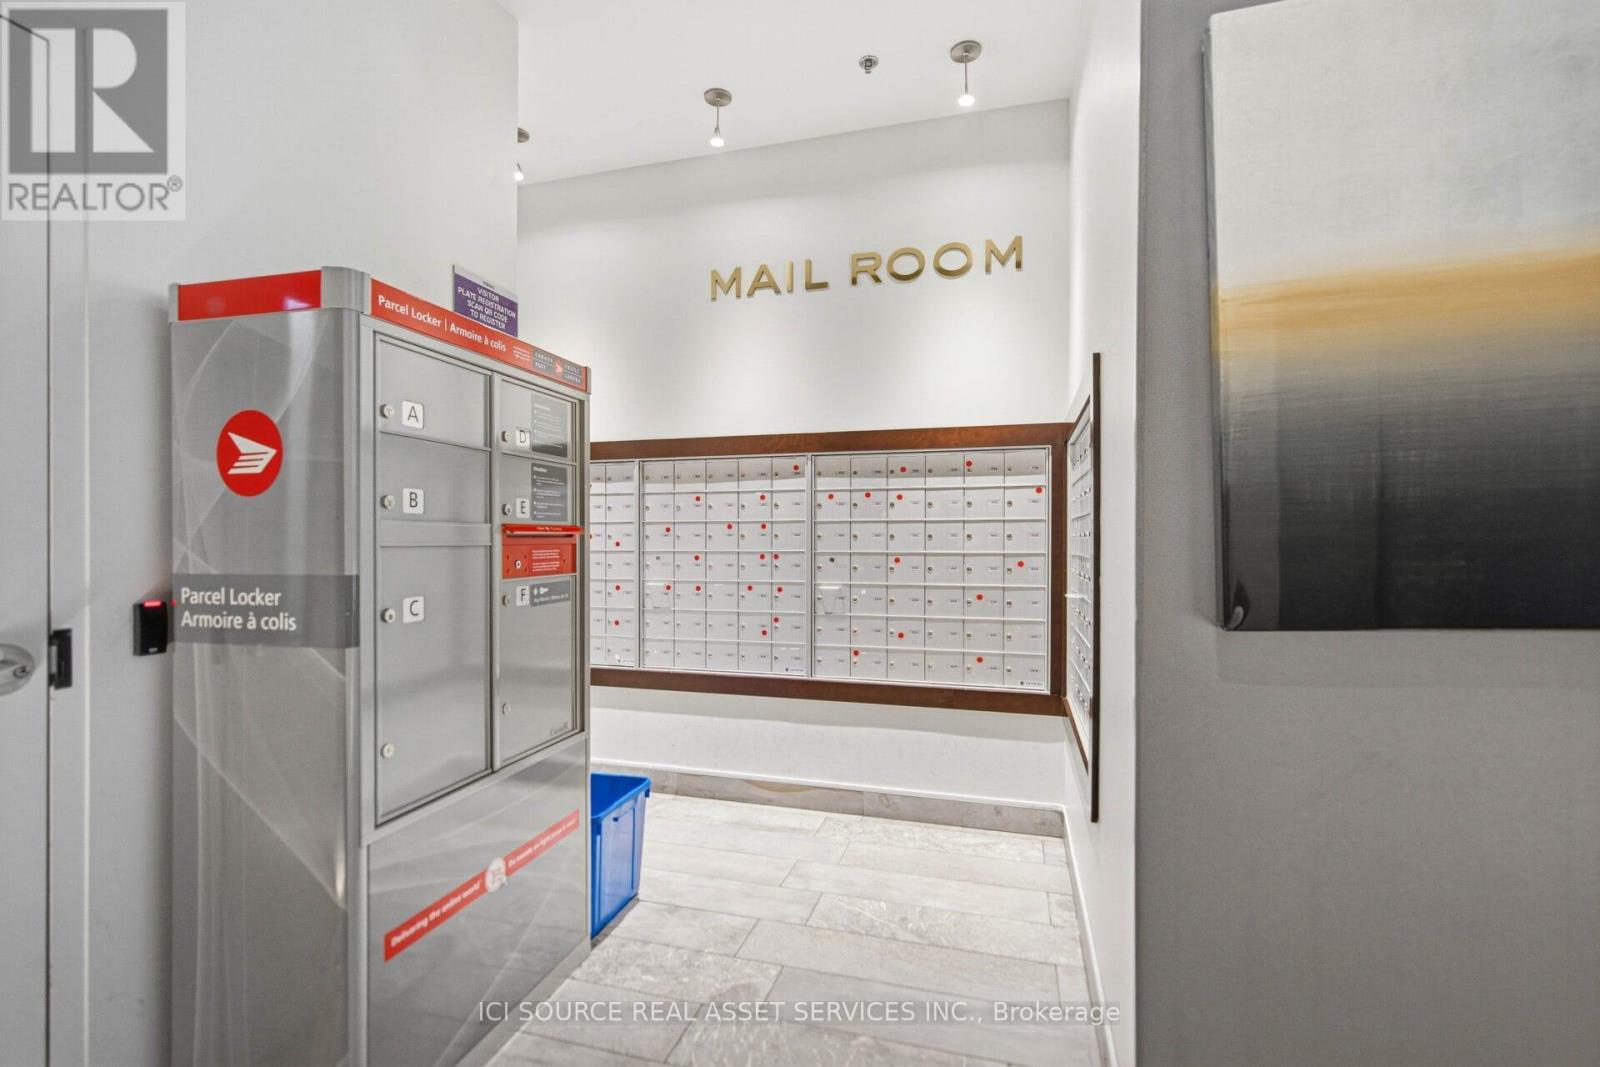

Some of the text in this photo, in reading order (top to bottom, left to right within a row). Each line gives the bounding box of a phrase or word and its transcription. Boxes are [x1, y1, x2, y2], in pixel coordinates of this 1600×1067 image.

[710, 235, 1024, 302] MAIL ROOM
[457, 286, 516, 319] PLATE REGISTRATION
[477, 287, 500, 303] VISITOR
[467, 299, 508, 323] SCAN QR CODE
[470, 309, 506, 330] TO REGISTER
[378, 294, 409, 316] Parcel
[411, 307, 442, 328] Locker
[450, 322, 483, 343] Armoire
[484, 335, 489, 346] à
[490, 339, 506, 353] colis
[407, 405, 419, 422] A
[519, 429, 527, 443] D
[409, 491, 418, 508] B
[520, 500, 526, 514] E
[180, 587, 282, 606] Parcel Locker
[520, 588, 526, 602] F
[409, 602, 419, 617] C
[180, 610, 297, 631] Armoire à colis
